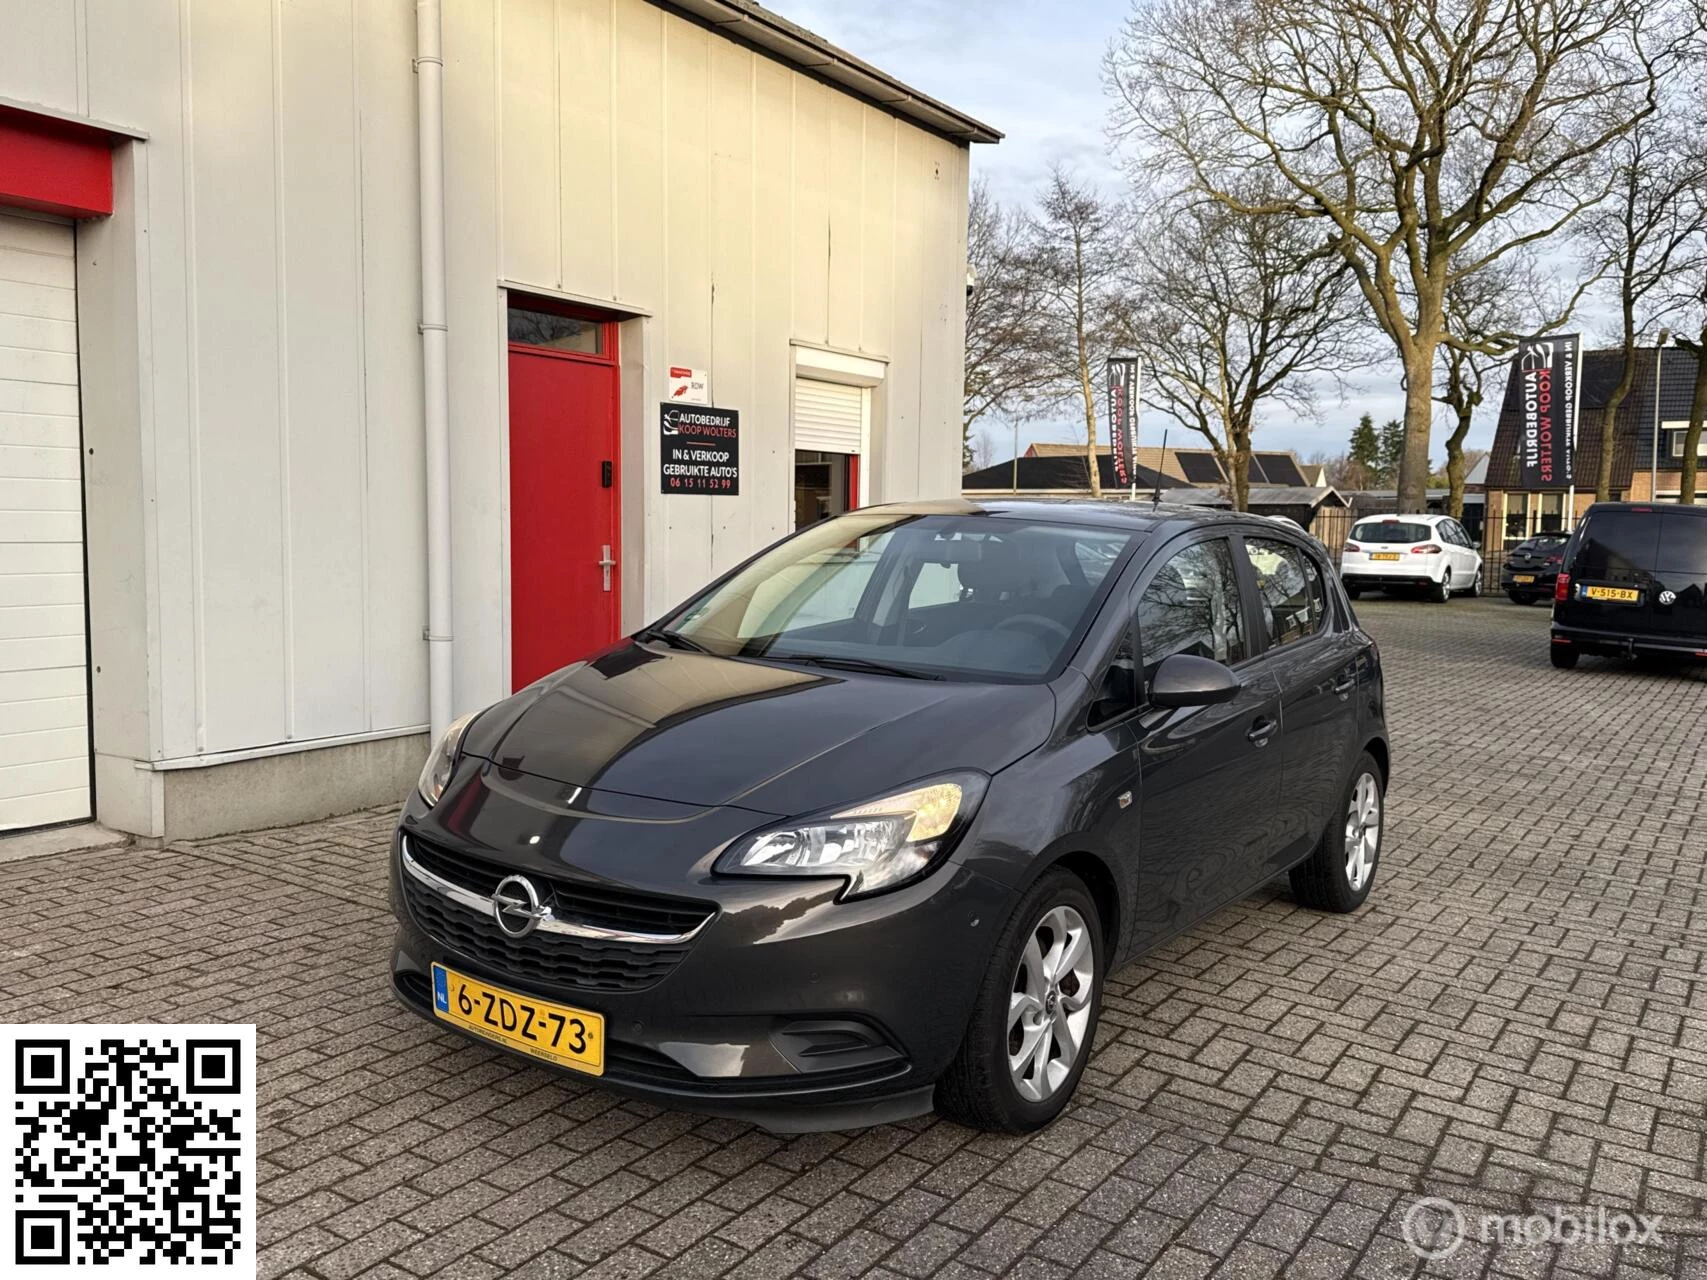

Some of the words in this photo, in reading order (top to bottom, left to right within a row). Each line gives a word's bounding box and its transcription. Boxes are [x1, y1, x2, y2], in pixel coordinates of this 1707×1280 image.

[680, 413, 731, 427] AUTOBEDRIJF
[680, 424, 702, 435] KOOP
[703, 427, 737, 438] WOLTERS
[672, 448, 682, 460] IN
[683, 449, 690, 460] &
[690, 450, 730, 463] VERKOOP
[663, 464, 710, 477] GEBRUIKTE
[710, 466, 738, 478] AUTO'S
[670, 477, 681, 487] 06
[685, 478, 694, 488] 15
[697, 479, 706, 488] 11
[709, 479, 719, 489] 52
[721, 479, 731, 489] 99
[1591, 587, 1633, 599] V-515-BX
[437, 991, 448, 1004] NL
[458, 984, 587, 1055] 6-ZDZ-73
